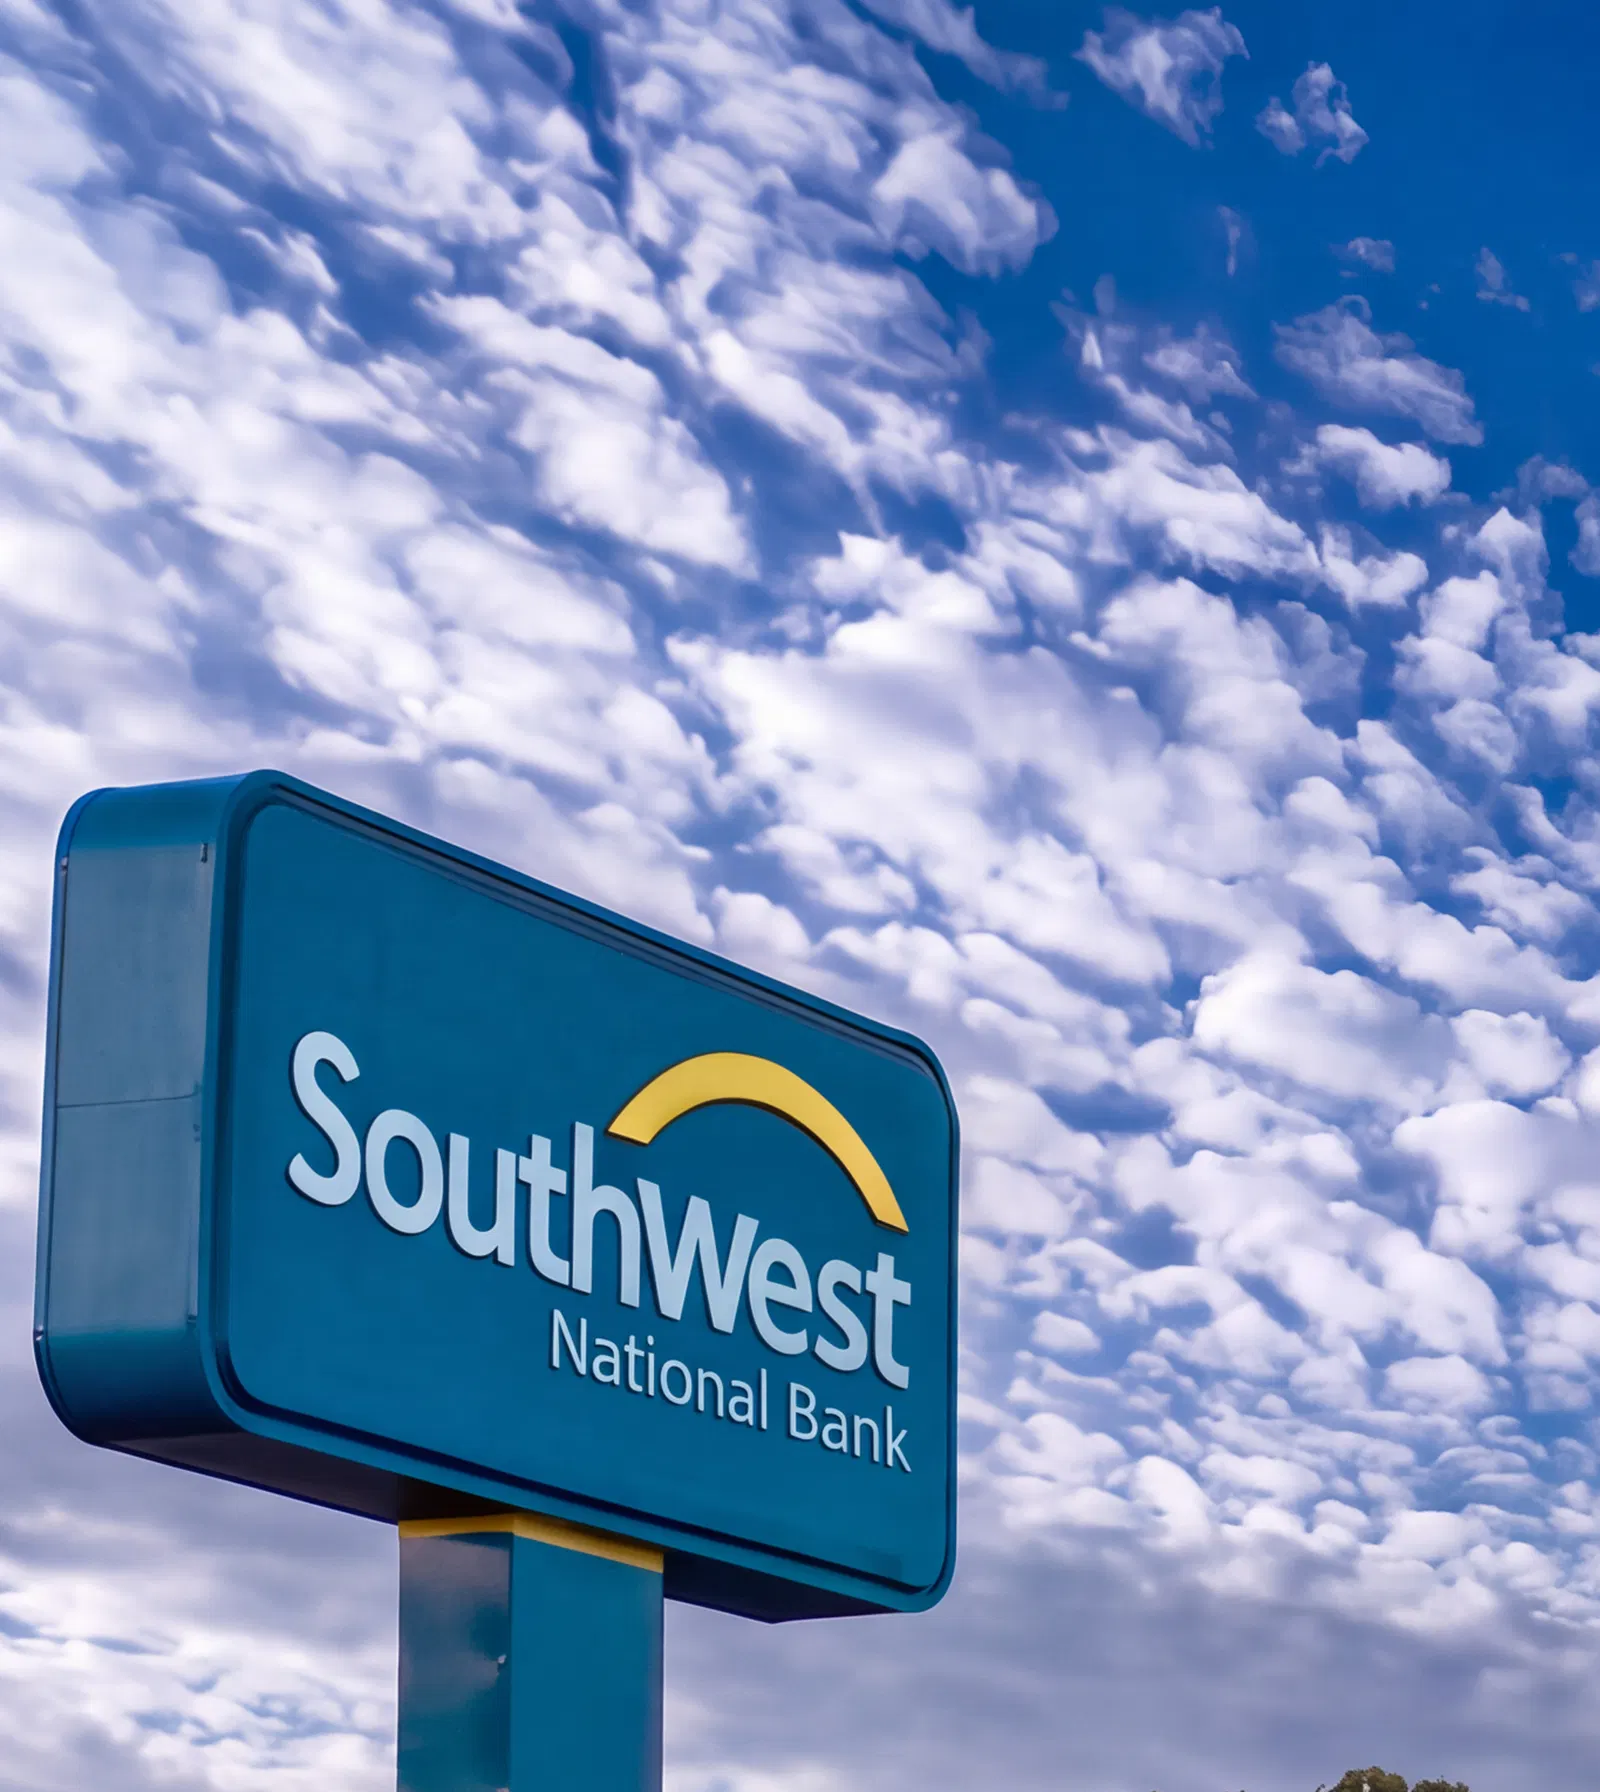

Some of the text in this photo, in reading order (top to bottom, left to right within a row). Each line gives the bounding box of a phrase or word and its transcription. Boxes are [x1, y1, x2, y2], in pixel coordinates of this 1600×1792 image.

[288, 1031, 912, 1389] SouthWest
[552, 1309, 912, 1472] National Bank
